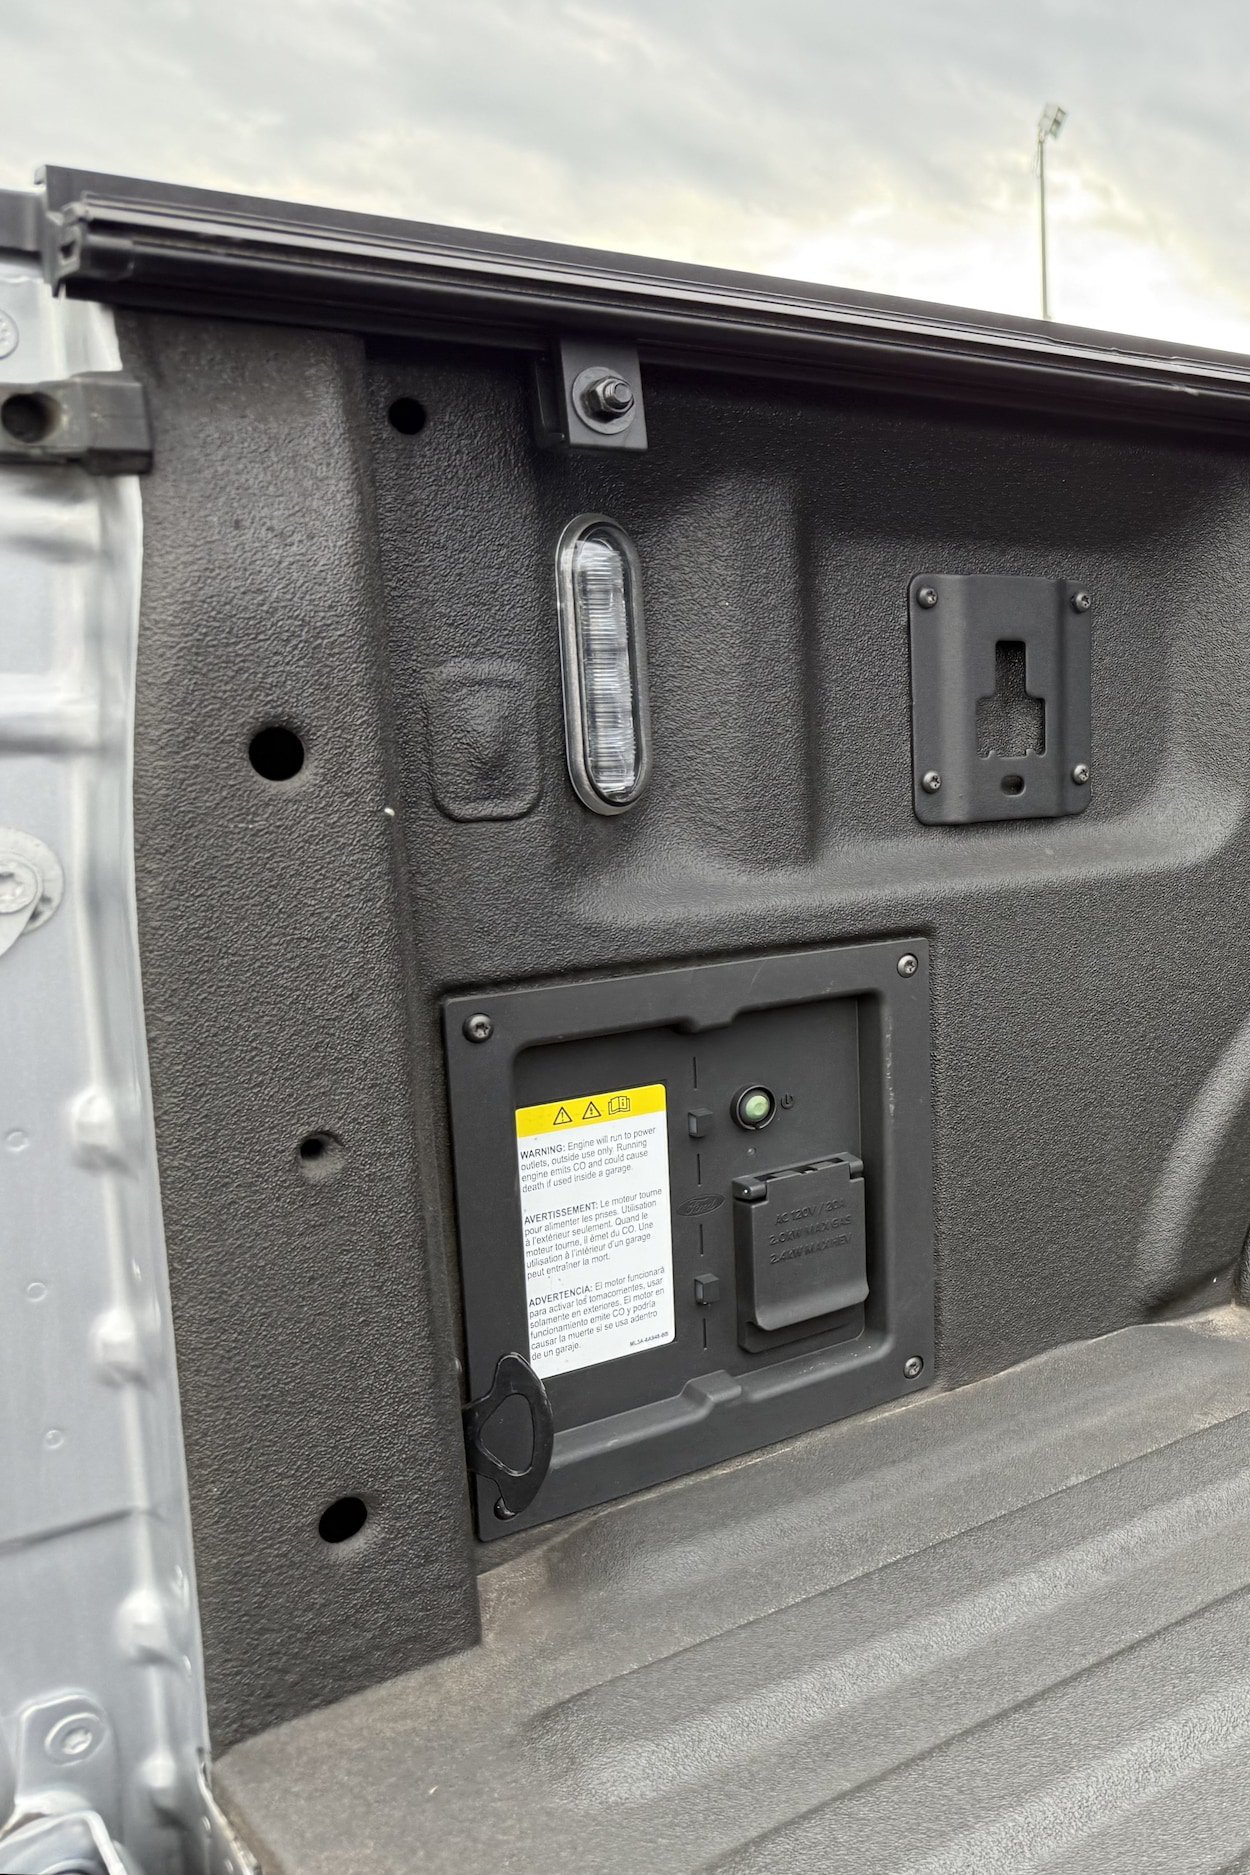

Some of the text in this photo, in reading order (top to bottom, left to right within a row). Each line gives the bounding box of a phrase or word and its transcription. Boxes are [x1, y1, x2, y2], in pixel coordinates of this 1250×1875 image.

[520, 1127, 656, 1160] WARNING: Engine will run to power
[520, 1159, 550, 1171] outlets,
[551, 1152, 580, 1165] outside
[581, 1150, 595, 1159] use
[616, 1140, 648, 1152] Running
[521, 1150, 649, 1182] engine emits CO and could cause
[522, 1181, 545, 1193] death
[546, 1178, 552, 1188] if
[553, 1174, 572, 1187] used
[573, 1170, 597, 1182] inside
[524, 1188, 662, 1224] AVERTISSEMENT: Le moteur tourne
[524, 1225, 543, 1236] pour
[581, 1214, 593, 1223] les
[594, 1209, 619, 1222] prises.
[621, 1201, 657, 1214] Utilisation
[525, 1239, 531, 1247] à
[614, 1213, 640, 1226] Quand
[641, 1211, 648, 1220] le
[525, 1221, 654, 1256] moteur tourne, il émet du CO. Une
[526, 1255, 563, 1268] utilisation
[564, 1250, 570, 1260] à
[607, 1239, 624, 1249] d'un
[625, 1232, 651, 1247] garage
[527, 1267, 545, 1280] peut
[582, 1257, 590, 1266] la
[591, 1252, 611, 1264] mort.
[528, 1266, 665, 1307] ADVERTENCIA: El motor funcionará
[529, 1308, 547, 1318] para
[548, 1300, 575, 1313] activar
[575, 1294, 587, 1306] los
[646, 1277, 663, 1288] usar
[529, 1287, 665, 1329] solamente en exteriores. El motor en
[530, 1319, 588, 1339] funcionamiento
[589, 1312, 611, 1324] emite
[612, 1307, 625, 1318] CO
[626, 1307, 631, 1316] y
[531, 1310, 658, 1350] causar la muerte si se usa adentro
[531, 1342, 581, 1361] de un garaje.
